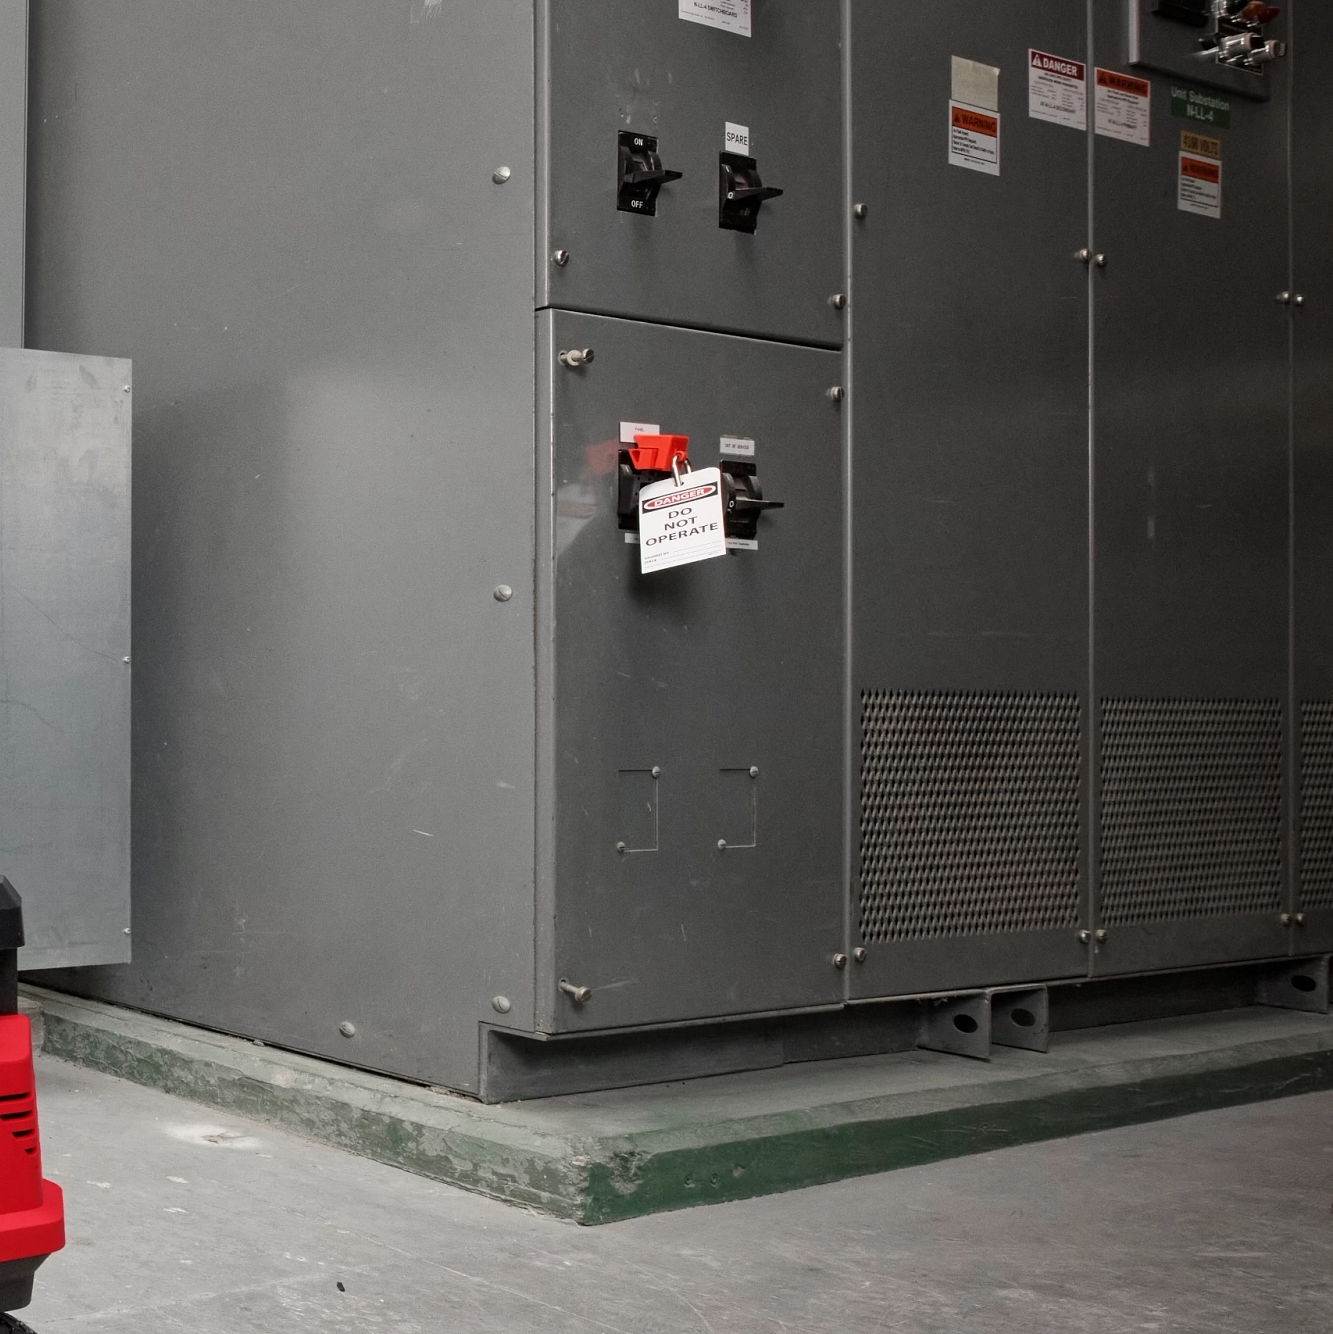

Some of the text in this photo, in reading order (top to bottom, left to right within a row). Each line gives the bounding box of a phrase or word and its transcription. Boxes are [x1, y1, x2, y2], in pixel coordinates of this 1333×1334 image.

[1043, 58, 1078, 77] DANGER
[1171, 86, 1230, 111] Unit Substation
[1186, 104, 1214, 122] N-LL-4
[962, 113, 997, 132] WARNING
[633, 137, 644, 147] ON
[726, 131, 748, 146] SPARE
[630, 200, 644, 209] OFF
[654, 488, 706, 507] DANGER
[668, 507, 693, 519] DO
[664, 516, 698, 531] NOT
[645, 522, 719, 547] OPERATE
